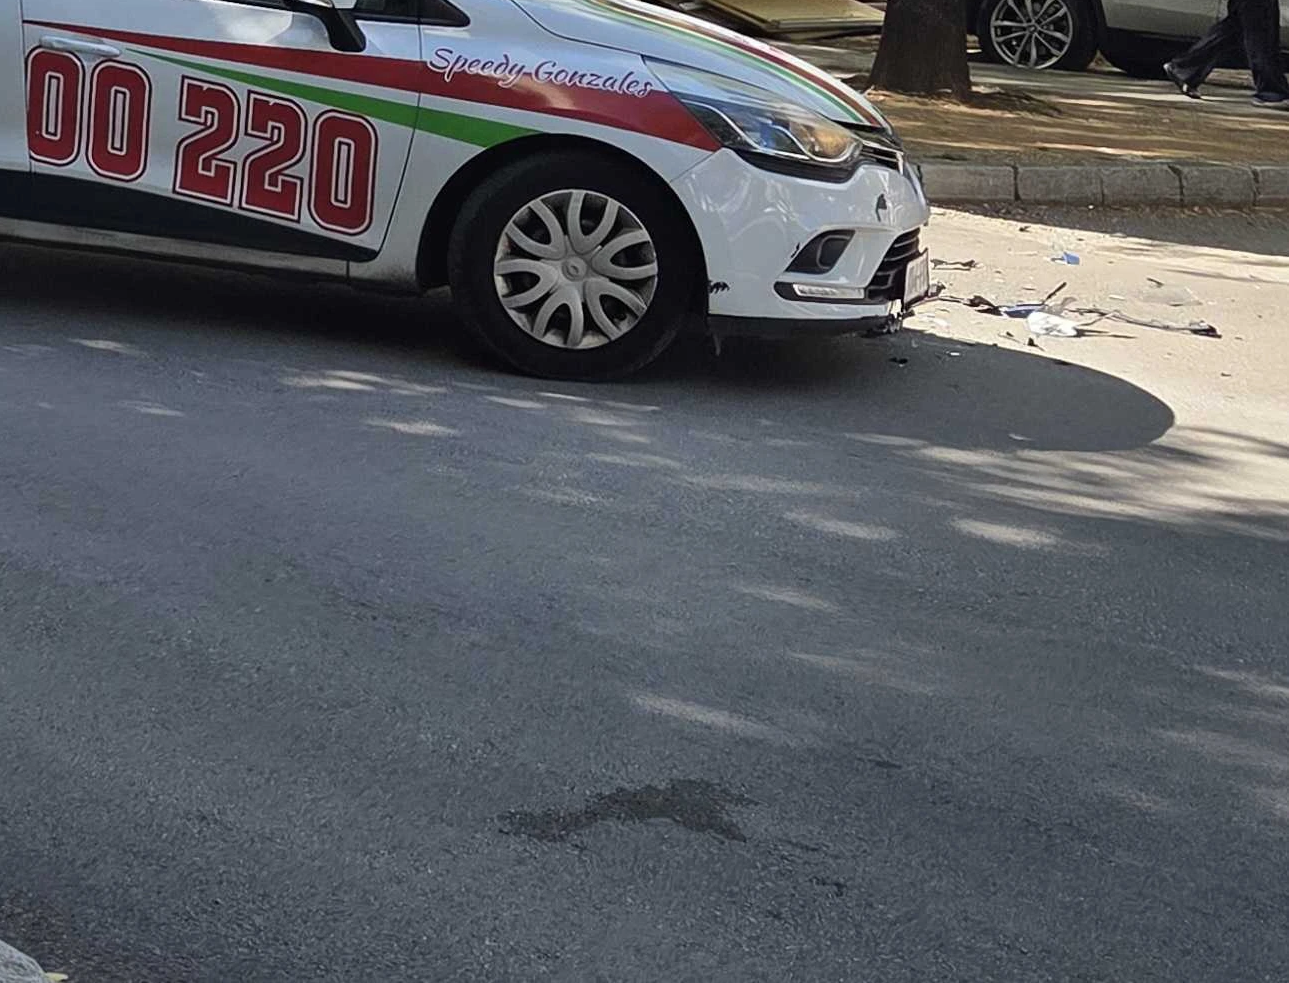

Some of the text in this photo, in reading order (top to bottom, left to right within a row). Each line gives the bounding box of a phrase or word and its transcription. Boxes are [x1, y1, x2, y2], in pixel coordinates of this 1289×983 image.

[427, 47, 653, 98] Speedy Gonzales
[25, 45, 379, 237] 00 220
